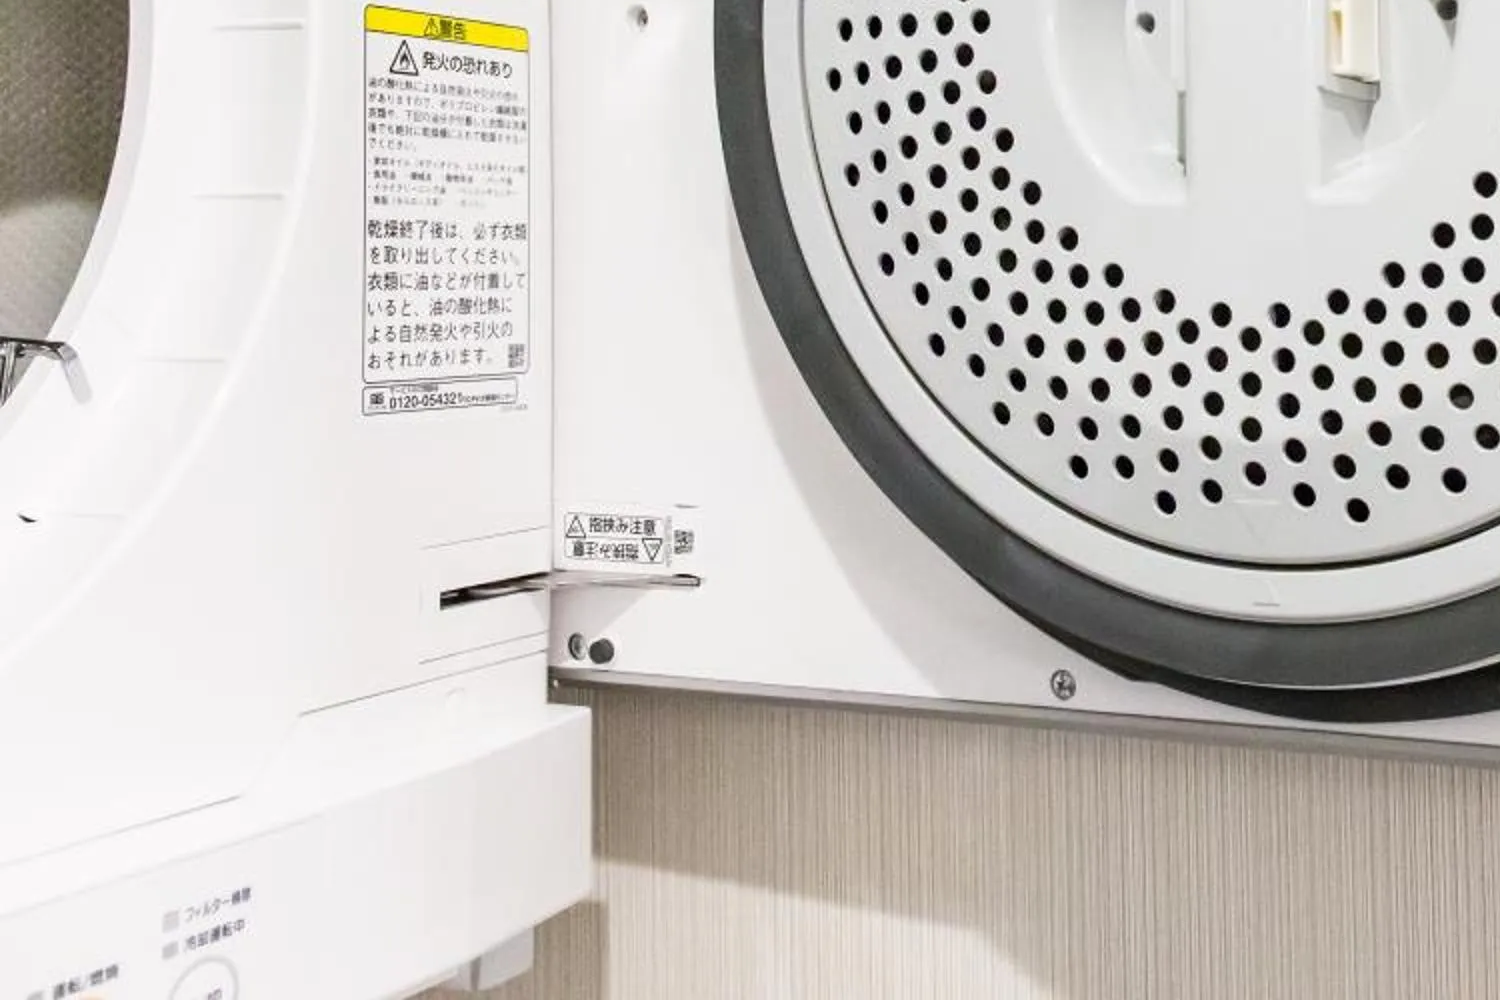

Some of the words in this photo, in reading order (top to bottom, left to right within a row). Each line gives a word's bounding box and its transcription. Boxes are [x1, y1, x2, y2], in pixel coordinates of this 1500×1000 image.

[439, 19, 467, 41] 警告
[422, 50, 513, 79] 発火の恐れあり
[368, 219, 527, 241] 乾燥終了後は、必ず衣類
[369, 246, 520, 265] を取り出してください。
[368, 272, 526, 291] 衣類に油などが付着して
[367, 296, 513, 317] いると、油の酸化熱に
[368, 321, 513, 344] よる自然発火や引火の
[368, 348, 493, 370] おそれがあります。
